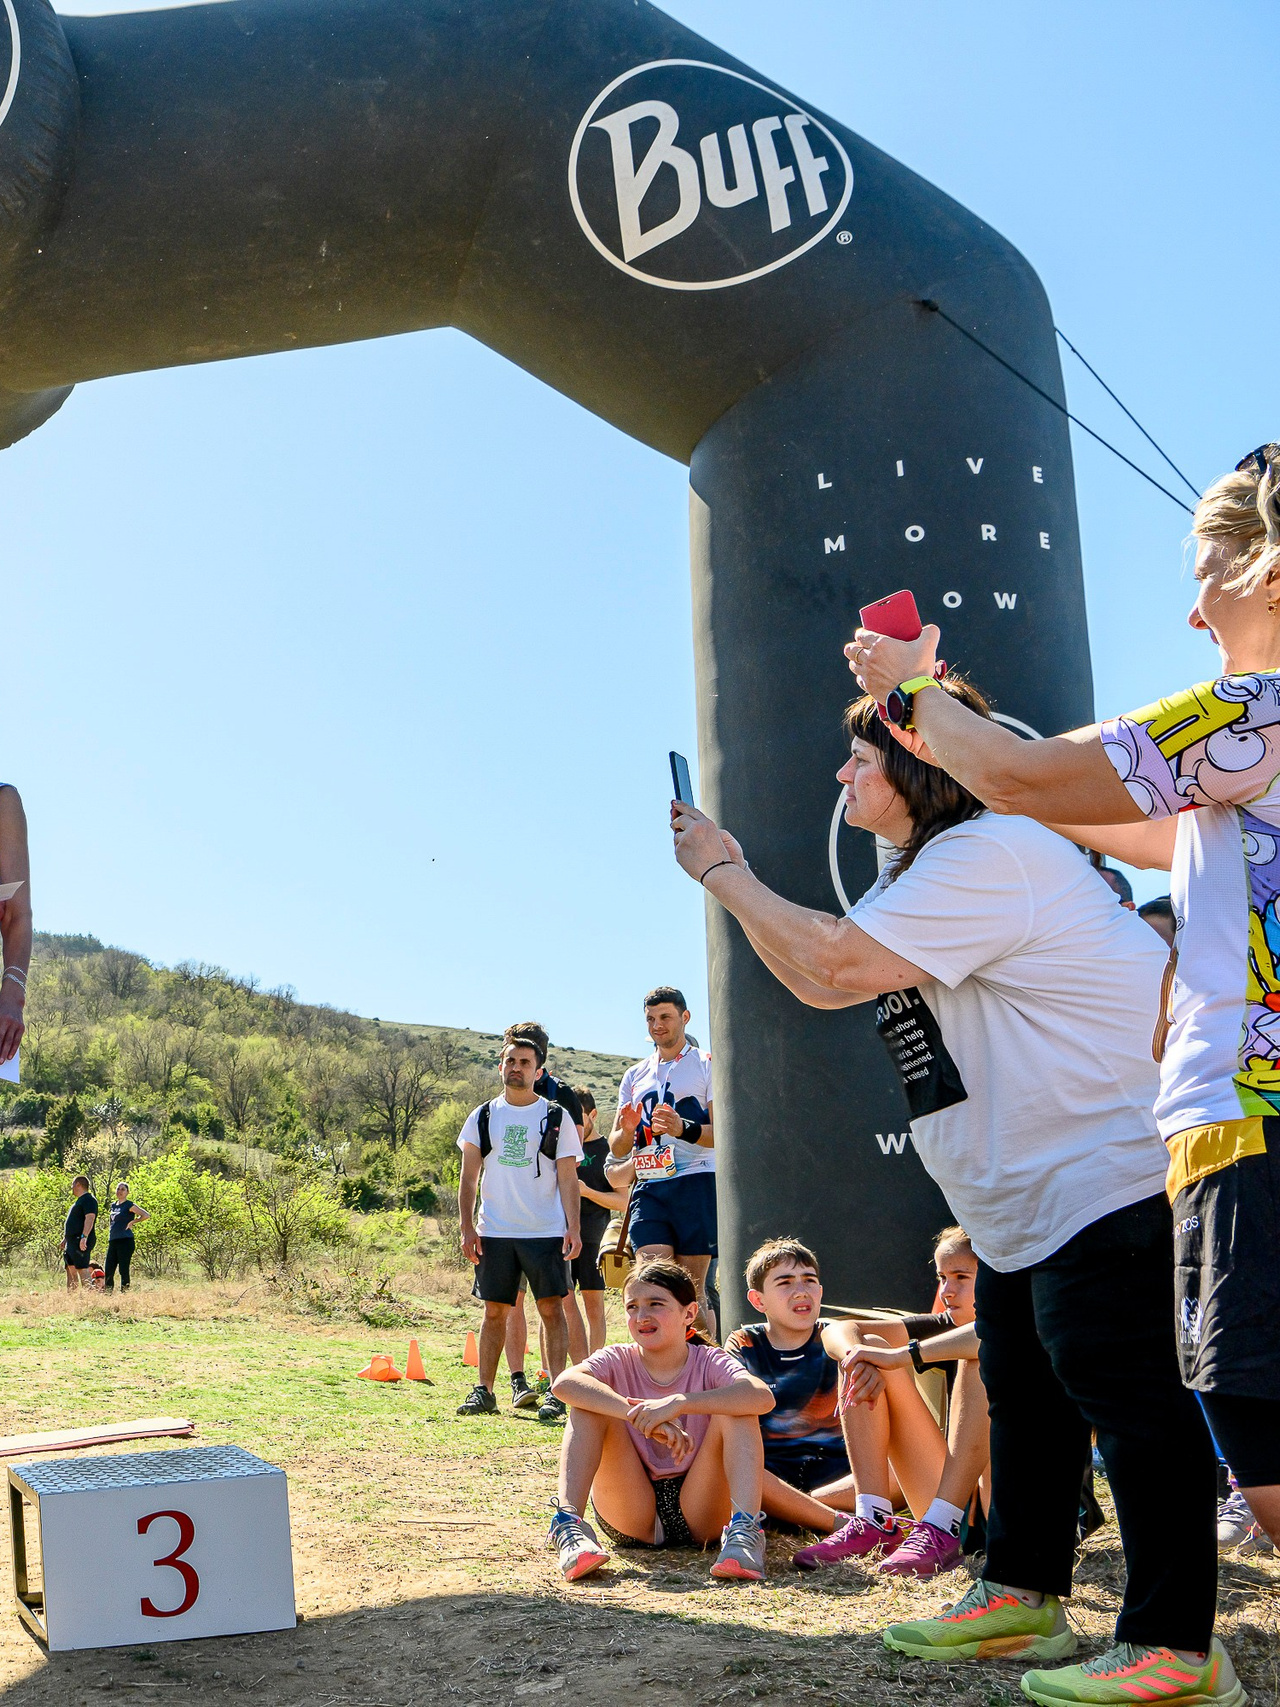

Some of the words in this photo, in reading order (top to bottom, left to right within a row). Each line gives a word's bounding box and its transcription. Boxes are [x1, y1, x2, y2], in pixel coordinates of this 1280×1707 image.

[817, 457, 1044, 490] LIVE
[823, 523, 1051, 555] MORE
[942, 590, 1017, 610] OW
[895, 1018, 917, 1033] show
[904, 1029, 925, 1043] help
[912, 1040, 929, 1053] not
[907, 1066, 930, 1081] raised
[632, 1156, 657, 1169] 2354
[136, 1509, 200, 1618] 3
